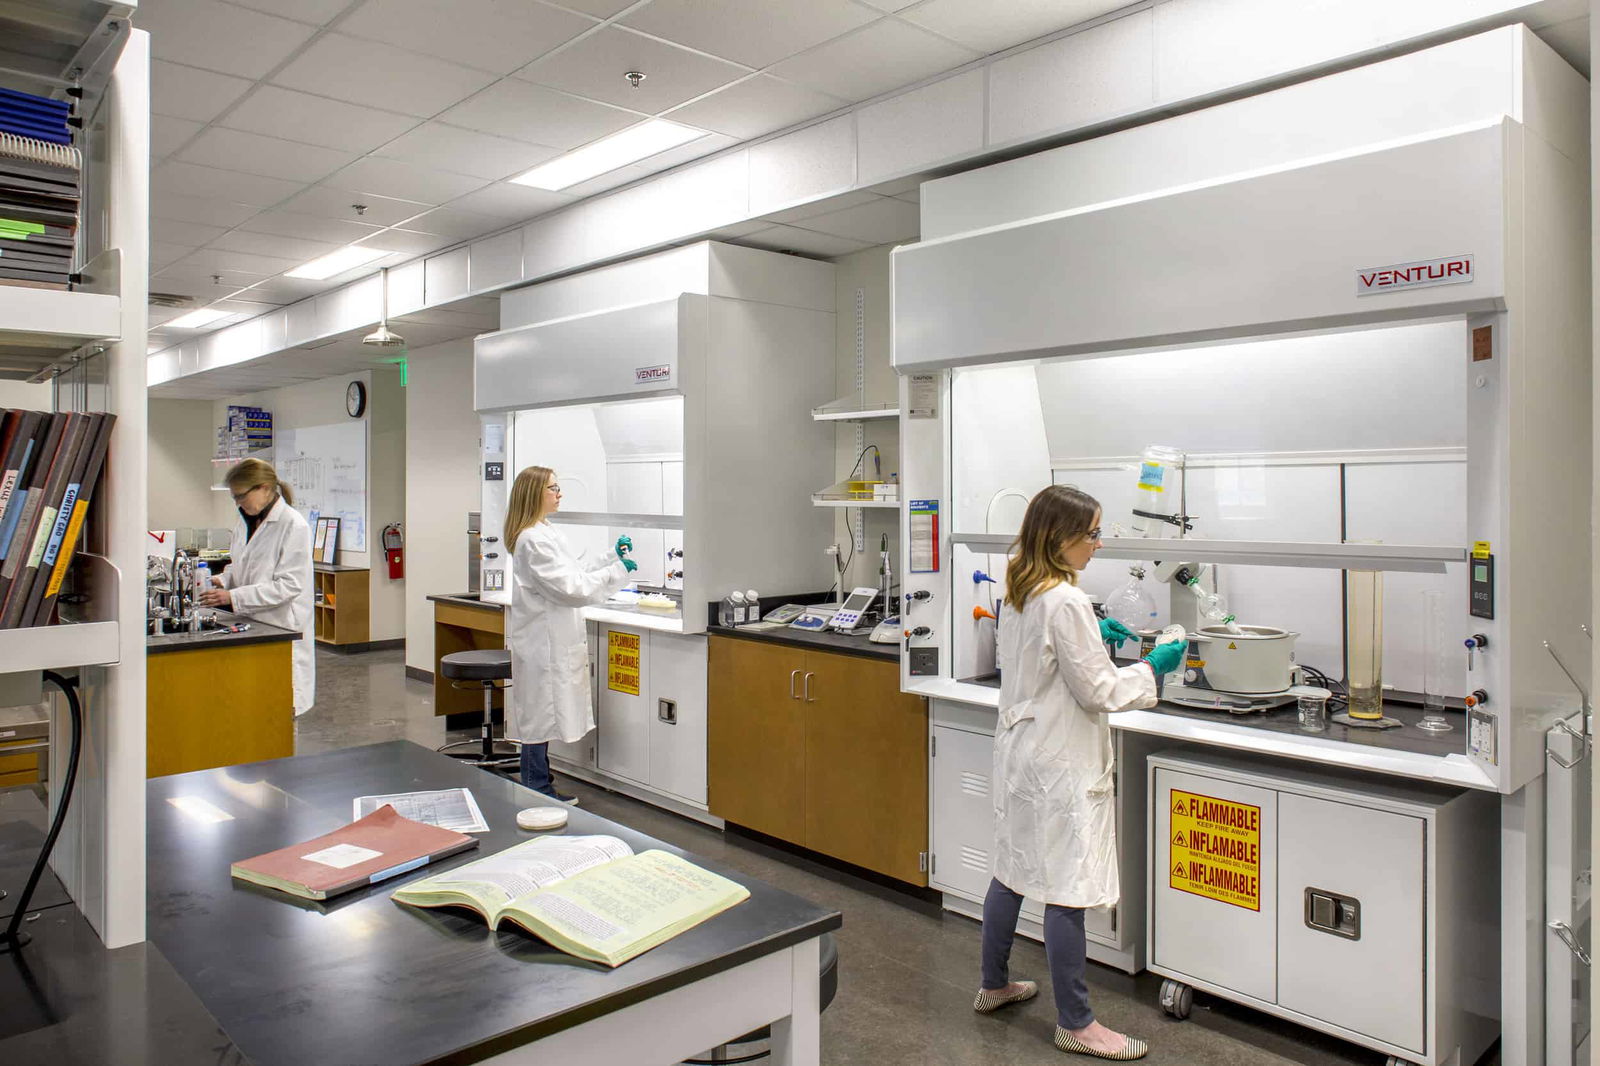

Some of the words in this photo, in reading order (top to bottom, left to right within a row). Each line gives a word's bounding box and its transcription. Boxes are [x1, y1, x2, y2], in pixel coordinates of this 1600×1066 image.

[1360, 260, 1470, 287] VENTURI
[636, 367, 670, 379] VENTURI
[1190, 798, 1256, 831] FLAMMABLE
[1196, 821, 1214, 829] KEEP
[1215, 824, 1229, 833] FIRE
[1231, 828, 1249, 837] AWAY
[1189, 830, 1256, 864] INFLAMABLE
[1189, 861, 1256, 897] INFLAMMABLE
[1205, 885, 1218, 894] LOIN
[1218, 889, 1229, 897] DES
